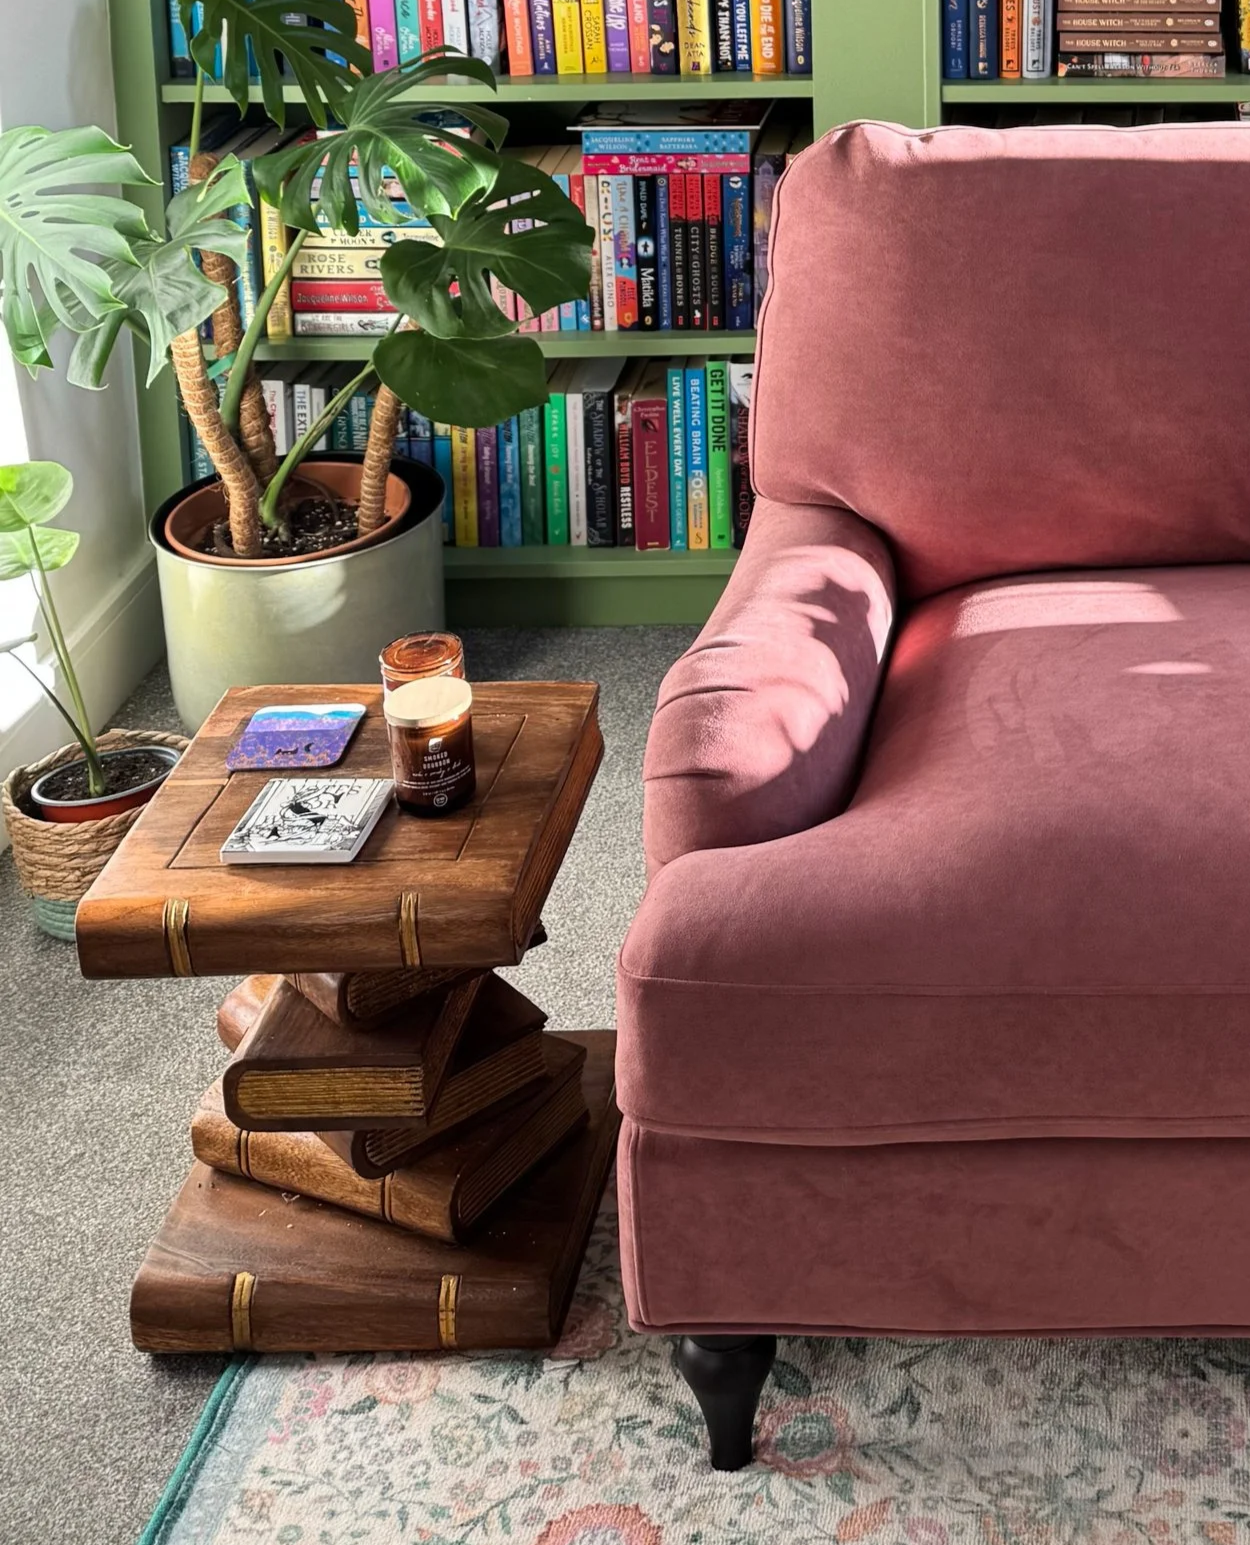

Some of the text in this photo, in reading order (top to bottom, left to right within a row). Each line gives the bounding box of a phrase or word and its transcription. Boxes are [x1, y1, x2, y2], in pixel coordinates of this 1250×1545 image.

[299, 264, 354, 275] RIVERS
[306, 254, 346, 264] ROSE
[640, 267, 653, 308] Matilda
[710, 368, 726, 452] GET IT DONE
